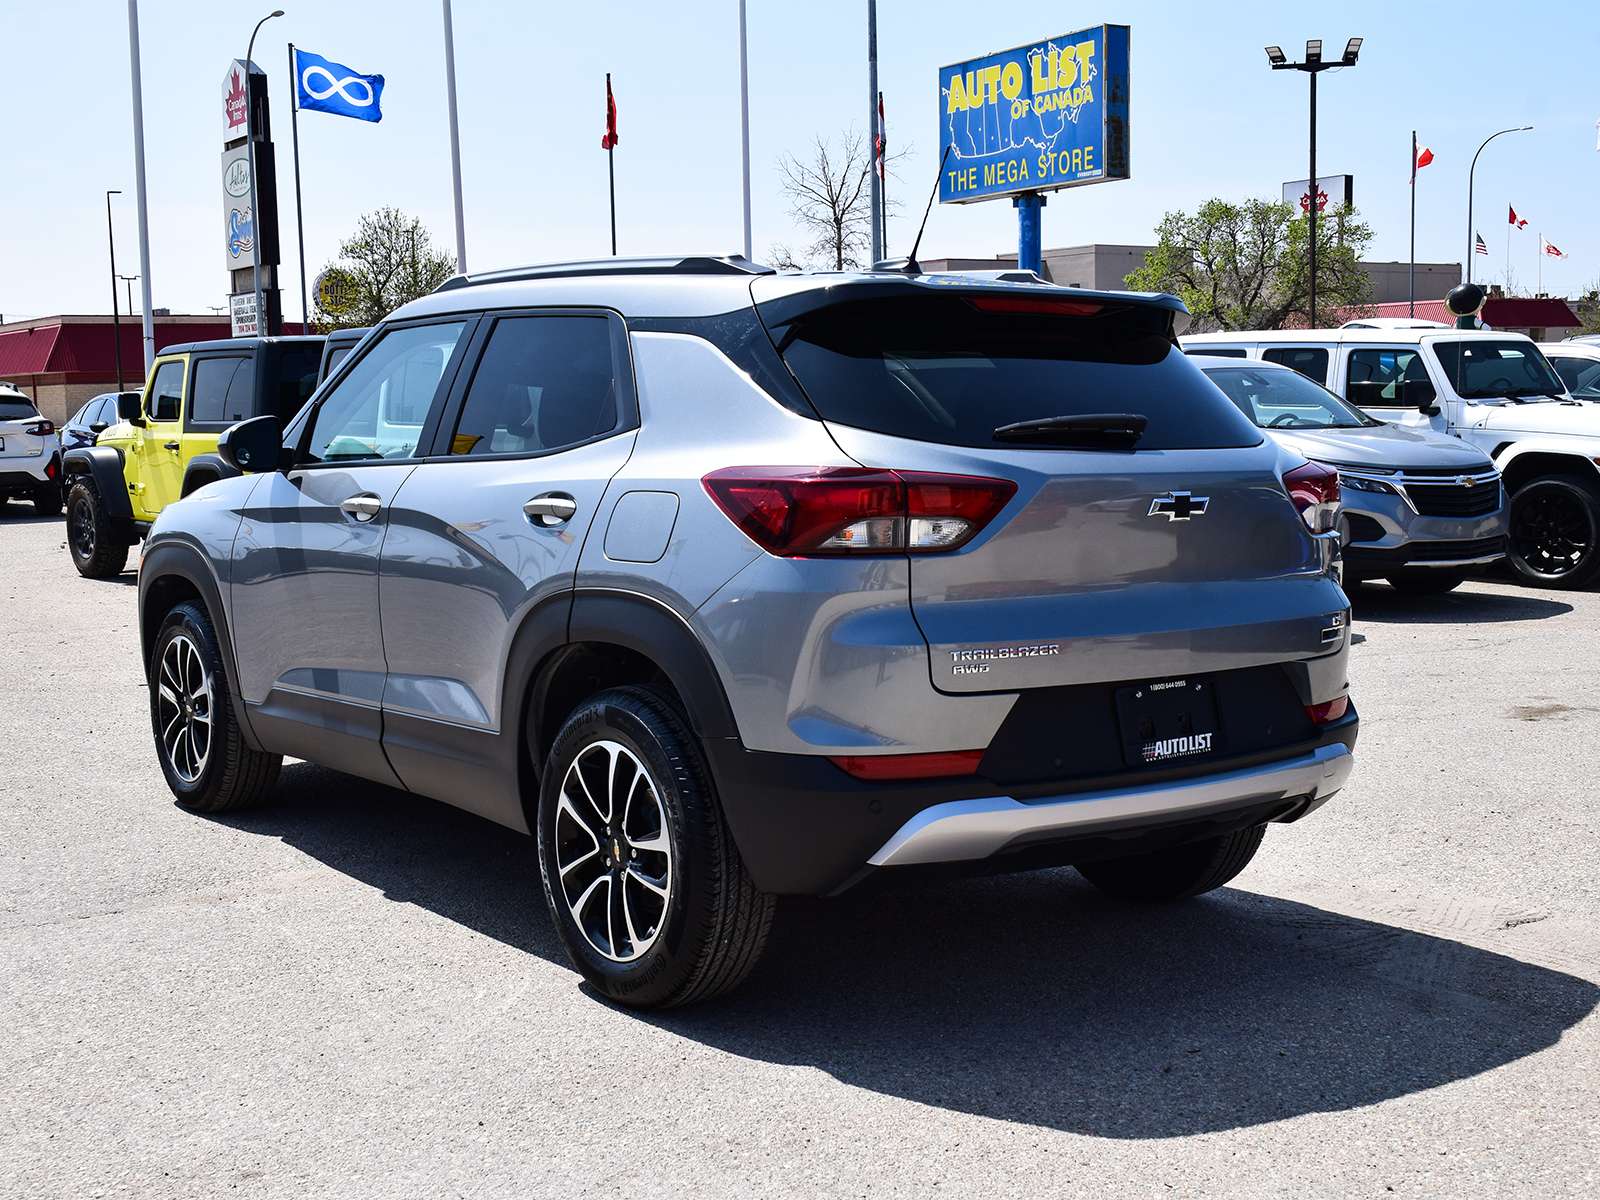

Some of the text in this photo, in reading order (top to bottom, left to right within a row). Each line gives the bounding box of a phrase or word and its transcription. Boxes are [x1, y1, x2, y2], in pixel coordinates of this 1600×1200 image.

[948, 40, 1095, 114] AUTO LIST
[1011, 85, 1094, 119] OF CANADA
[949, 146, 1094, 192] THE MEGA STORE
[950, 644, 1059, 662] TRAILBLAZER
[952, 663, 990, 675] AWD
